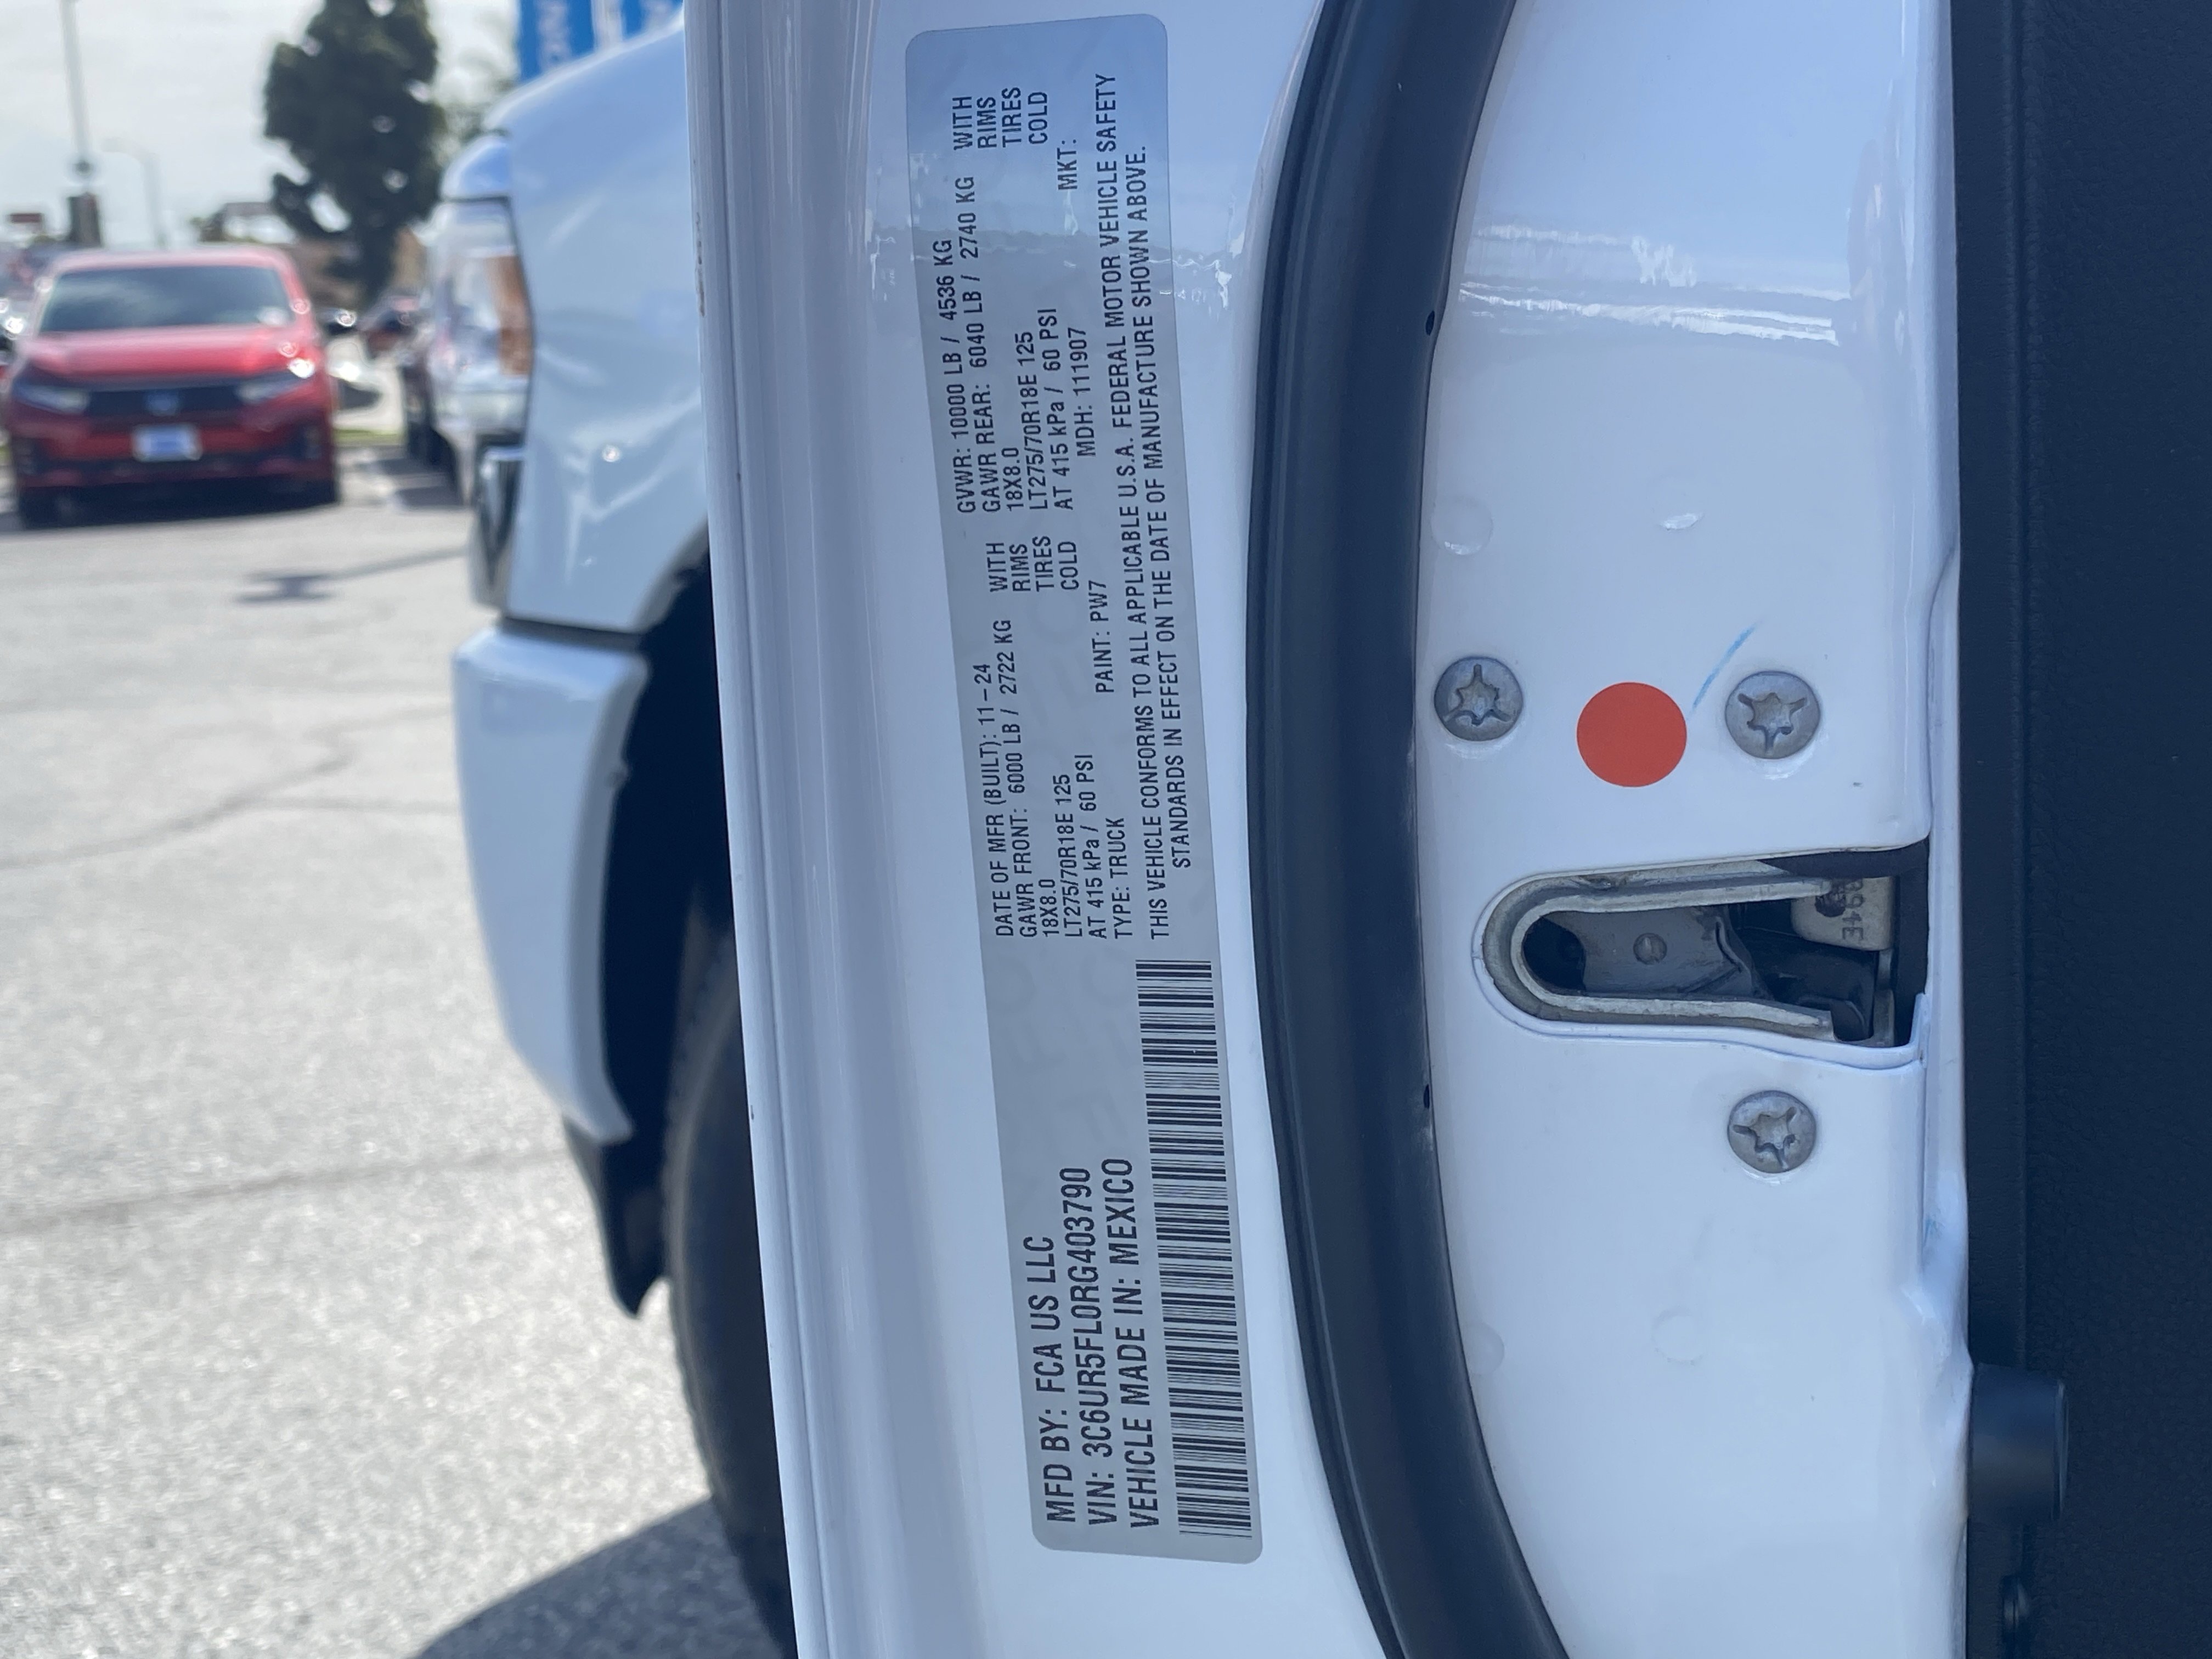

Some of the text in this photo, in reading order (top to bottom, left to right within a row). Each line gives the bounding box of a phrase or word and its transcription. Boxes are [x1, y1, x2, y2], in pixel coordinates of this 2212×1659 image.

[952, 97, 973, 150] WITH
[977, 97, 997, 148] RIMS
[1002, 87, 1022, 148] TIRES
[1028, 92, 1048, 144] COLD
[1057, 139, 1077, 190] MKT:
[955, 177, 975, 203] KG
[933, 240, 953, 266] KG
[958, 213, 978, 259] 2740
[936, 276, 957, 320] 4536
[962, 291, 983, 313] LB
[966, 323, 987, 368] 6040
[1037, 309, 1058, 340] PSI
[943, 353, 962, 374] LB
[1042, 349, 1061, 371] 60
[946, 384, 968, 439] 10000
[972, 385, 995, 444] REAR:
[1068, 327, 1096, 456] MDH: 111907
[1015, 332, 1048, 509] LT275/70R18E 125
[1047, 402, 1066, 436] kPa
[953, 448, 976, 512] GVWR:
[978, 453, 1001, 512] GAWR
[1001, 448, 1024, 511] 18X8.0
[1050, 443, 1070, 476] 415
[1053, 486, 1073, 510] AT
[1096, 74, 1169, 940] THIS VEHICLE CONFORMS TO ALL APPLICABLE U.S.A. FEDERAL MOTOR VEHICLE SAFETY
[1125, 146, 1190, 868] STANDARDS IN EFFECT ON THE DATE OF MANUFACTURE SHOWN ABOVE.
[986, 543, 1008, 592] WITH
[1009, 544, 1031, 591] RIMS
[1032, 536, 1054, 592] TIRES
[1058, 541, 1079, 590] COLD
[993, 620, 1013, 644] KG
[1088, 580, 1114, 692] PAINT: PW7
[997, 652, 1017, 694] 2722
[1002, 724, 1021, 743] LB
[979, 735, 1007, 805] (BUILT):
[1006, 753, 1025, 793] 6000
[1074, 755, 1094, 782] PSI
[1079, 792, 1096, 811] 60
[986, 814, 1006, 853] MFR
[1009, 809, 1032, 874] FRONT:
[1053, 775, 1082, 936] LT275/70R18E 125
[1082, 839, 1101, 870] kPa
[990, 861, 1008, 883] OF
[1085, 878, 1104, 908] 415
[1105, 818, 1132, 939] TYPE: TRUCK
[992, 891, 1013, 936] DATE
[1015, 883, 1037, 937] GAWR
[1039, 879, 1059, 937] 18X8.0
[1087, 916, 1107, 939] AT
[1059, 1168, 1117, 1525] VIN: 3C6UR5FL0RG403790
[1101, 1159, 1159, 1528] VEHICLE MADE IN: MEXICO
[1023, 1237, 1075, 1522] MFD BY: FCA US LLC
